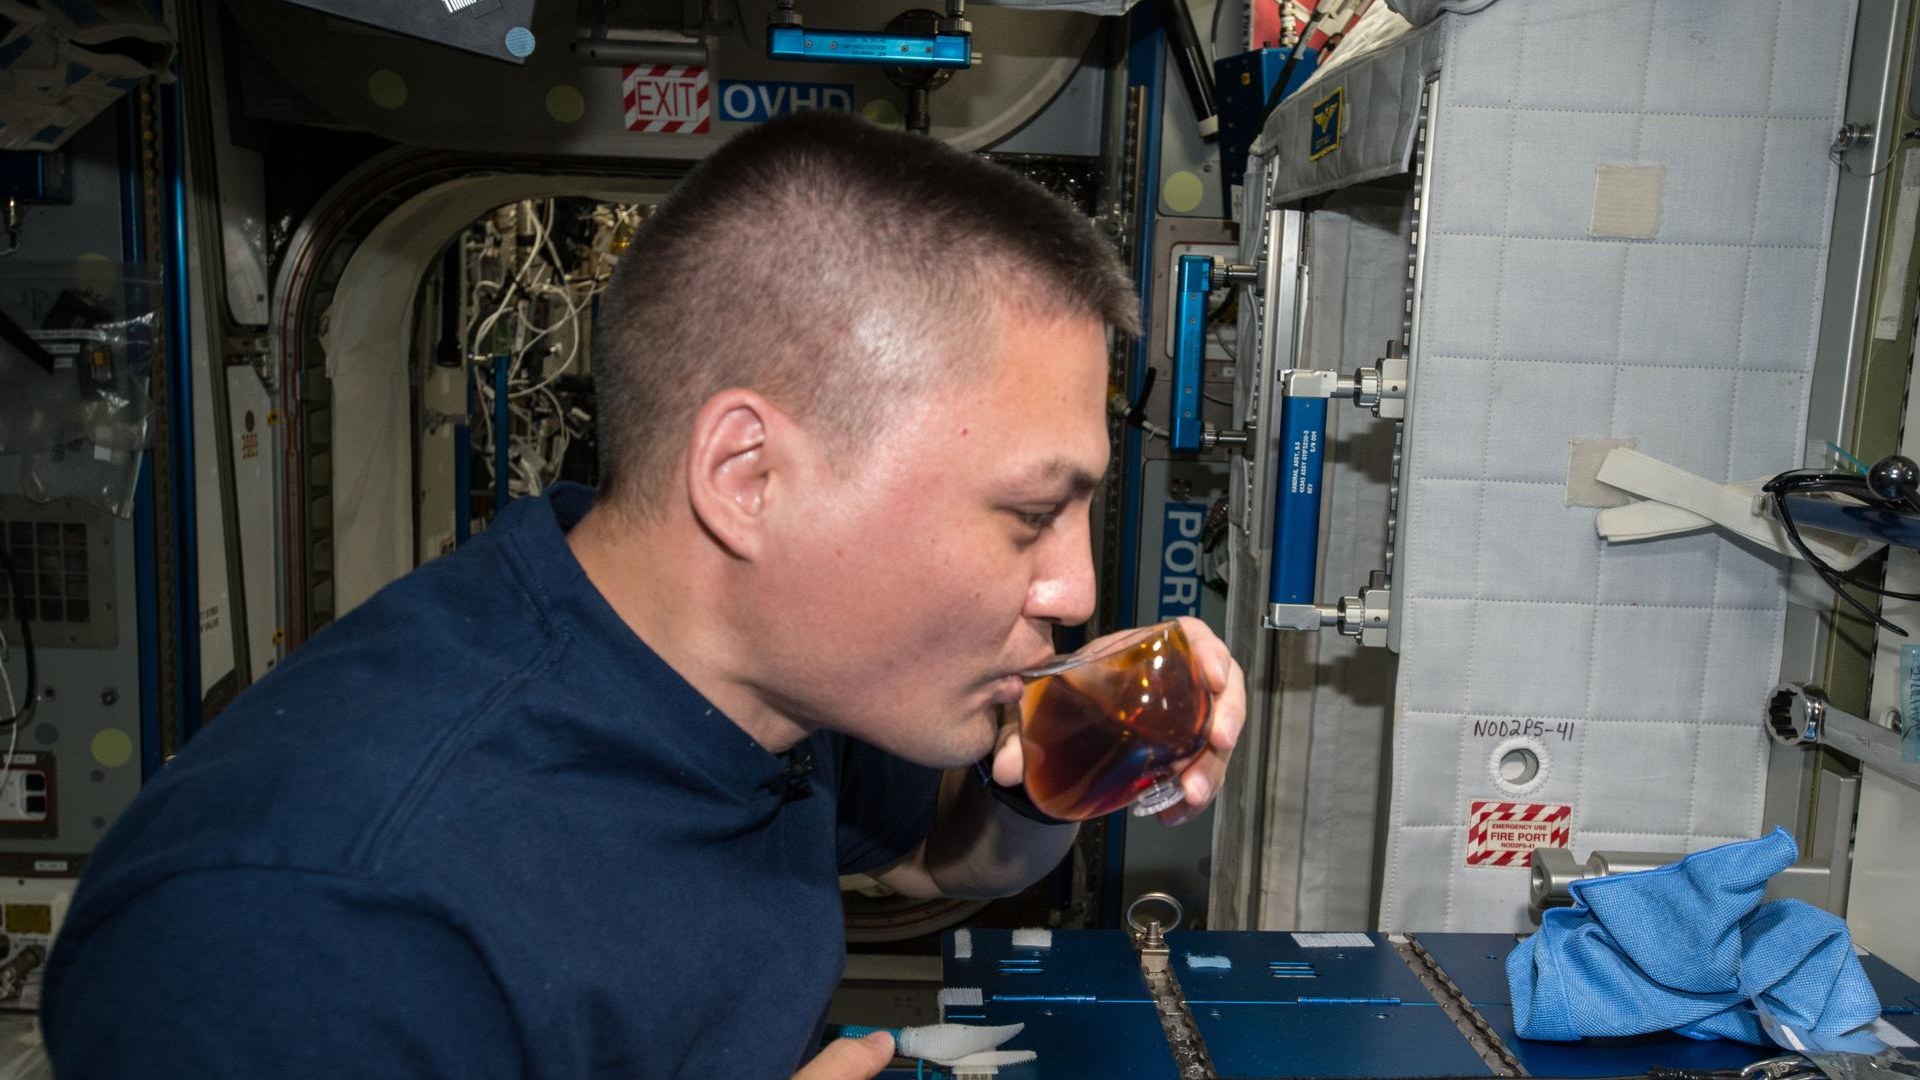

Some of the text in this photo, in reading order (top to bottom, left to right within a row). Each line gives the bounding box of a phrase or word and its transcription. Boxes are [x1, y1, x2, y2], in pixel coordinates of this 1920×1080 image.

[636, 80, 696, 117] EXIT
[723, 84, 849, 119] OVHD
[1490, 832, 1548, 842] FIRE PORT
